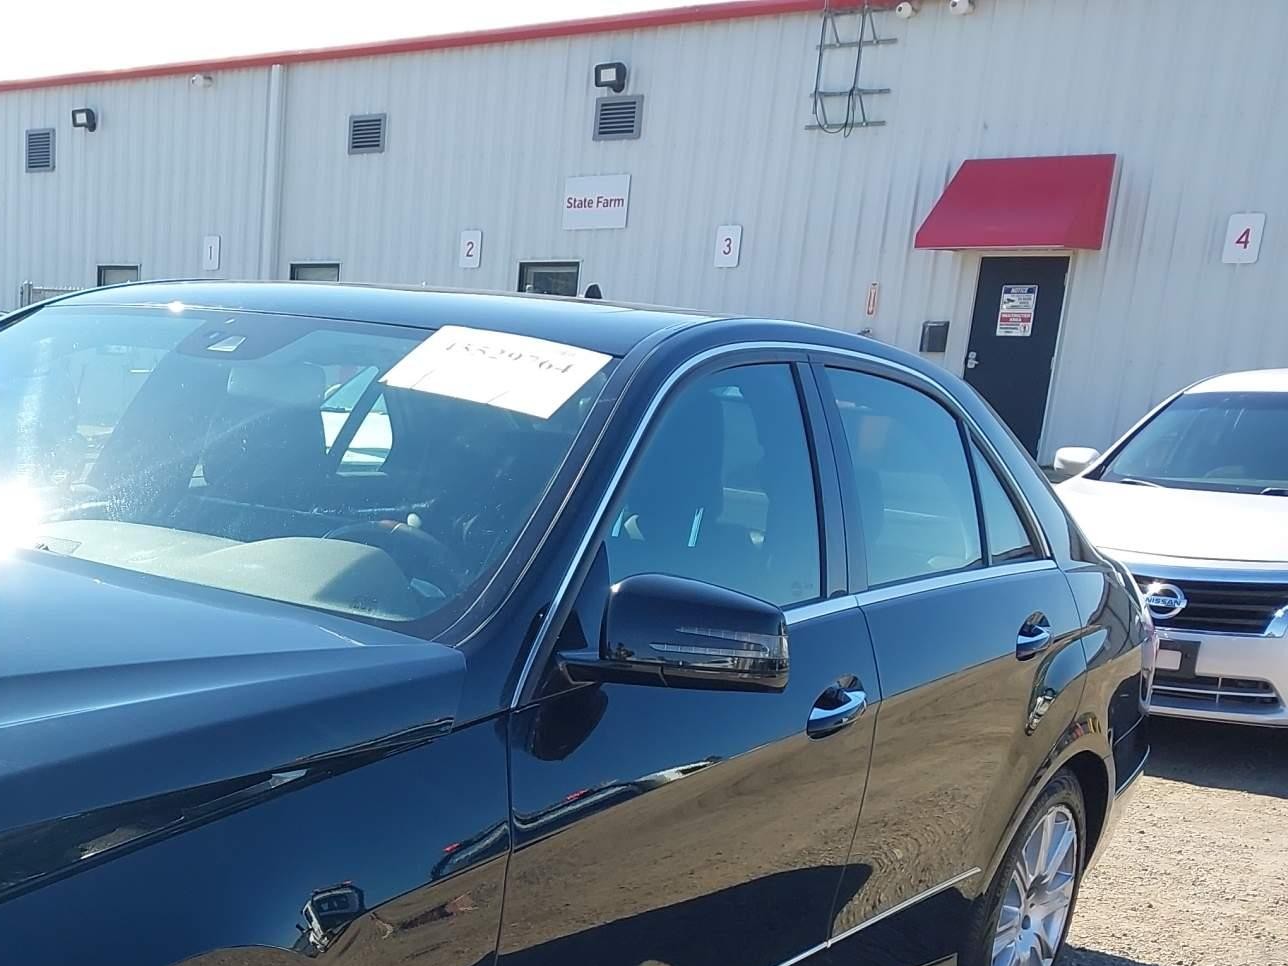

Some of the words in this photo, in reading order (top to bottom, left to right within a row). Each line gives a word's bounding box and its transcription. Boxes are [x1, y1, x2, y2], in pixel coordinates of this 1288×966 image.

[566, 196, 594, 210] State
[596, 195, 625, 210] Farm
[722, 237, 732, 256] 3
[1235, 227, 1252, 250] 4
[465, 241, 475, 258] 2
[1145, 597, 1181, 606] NISSAN
